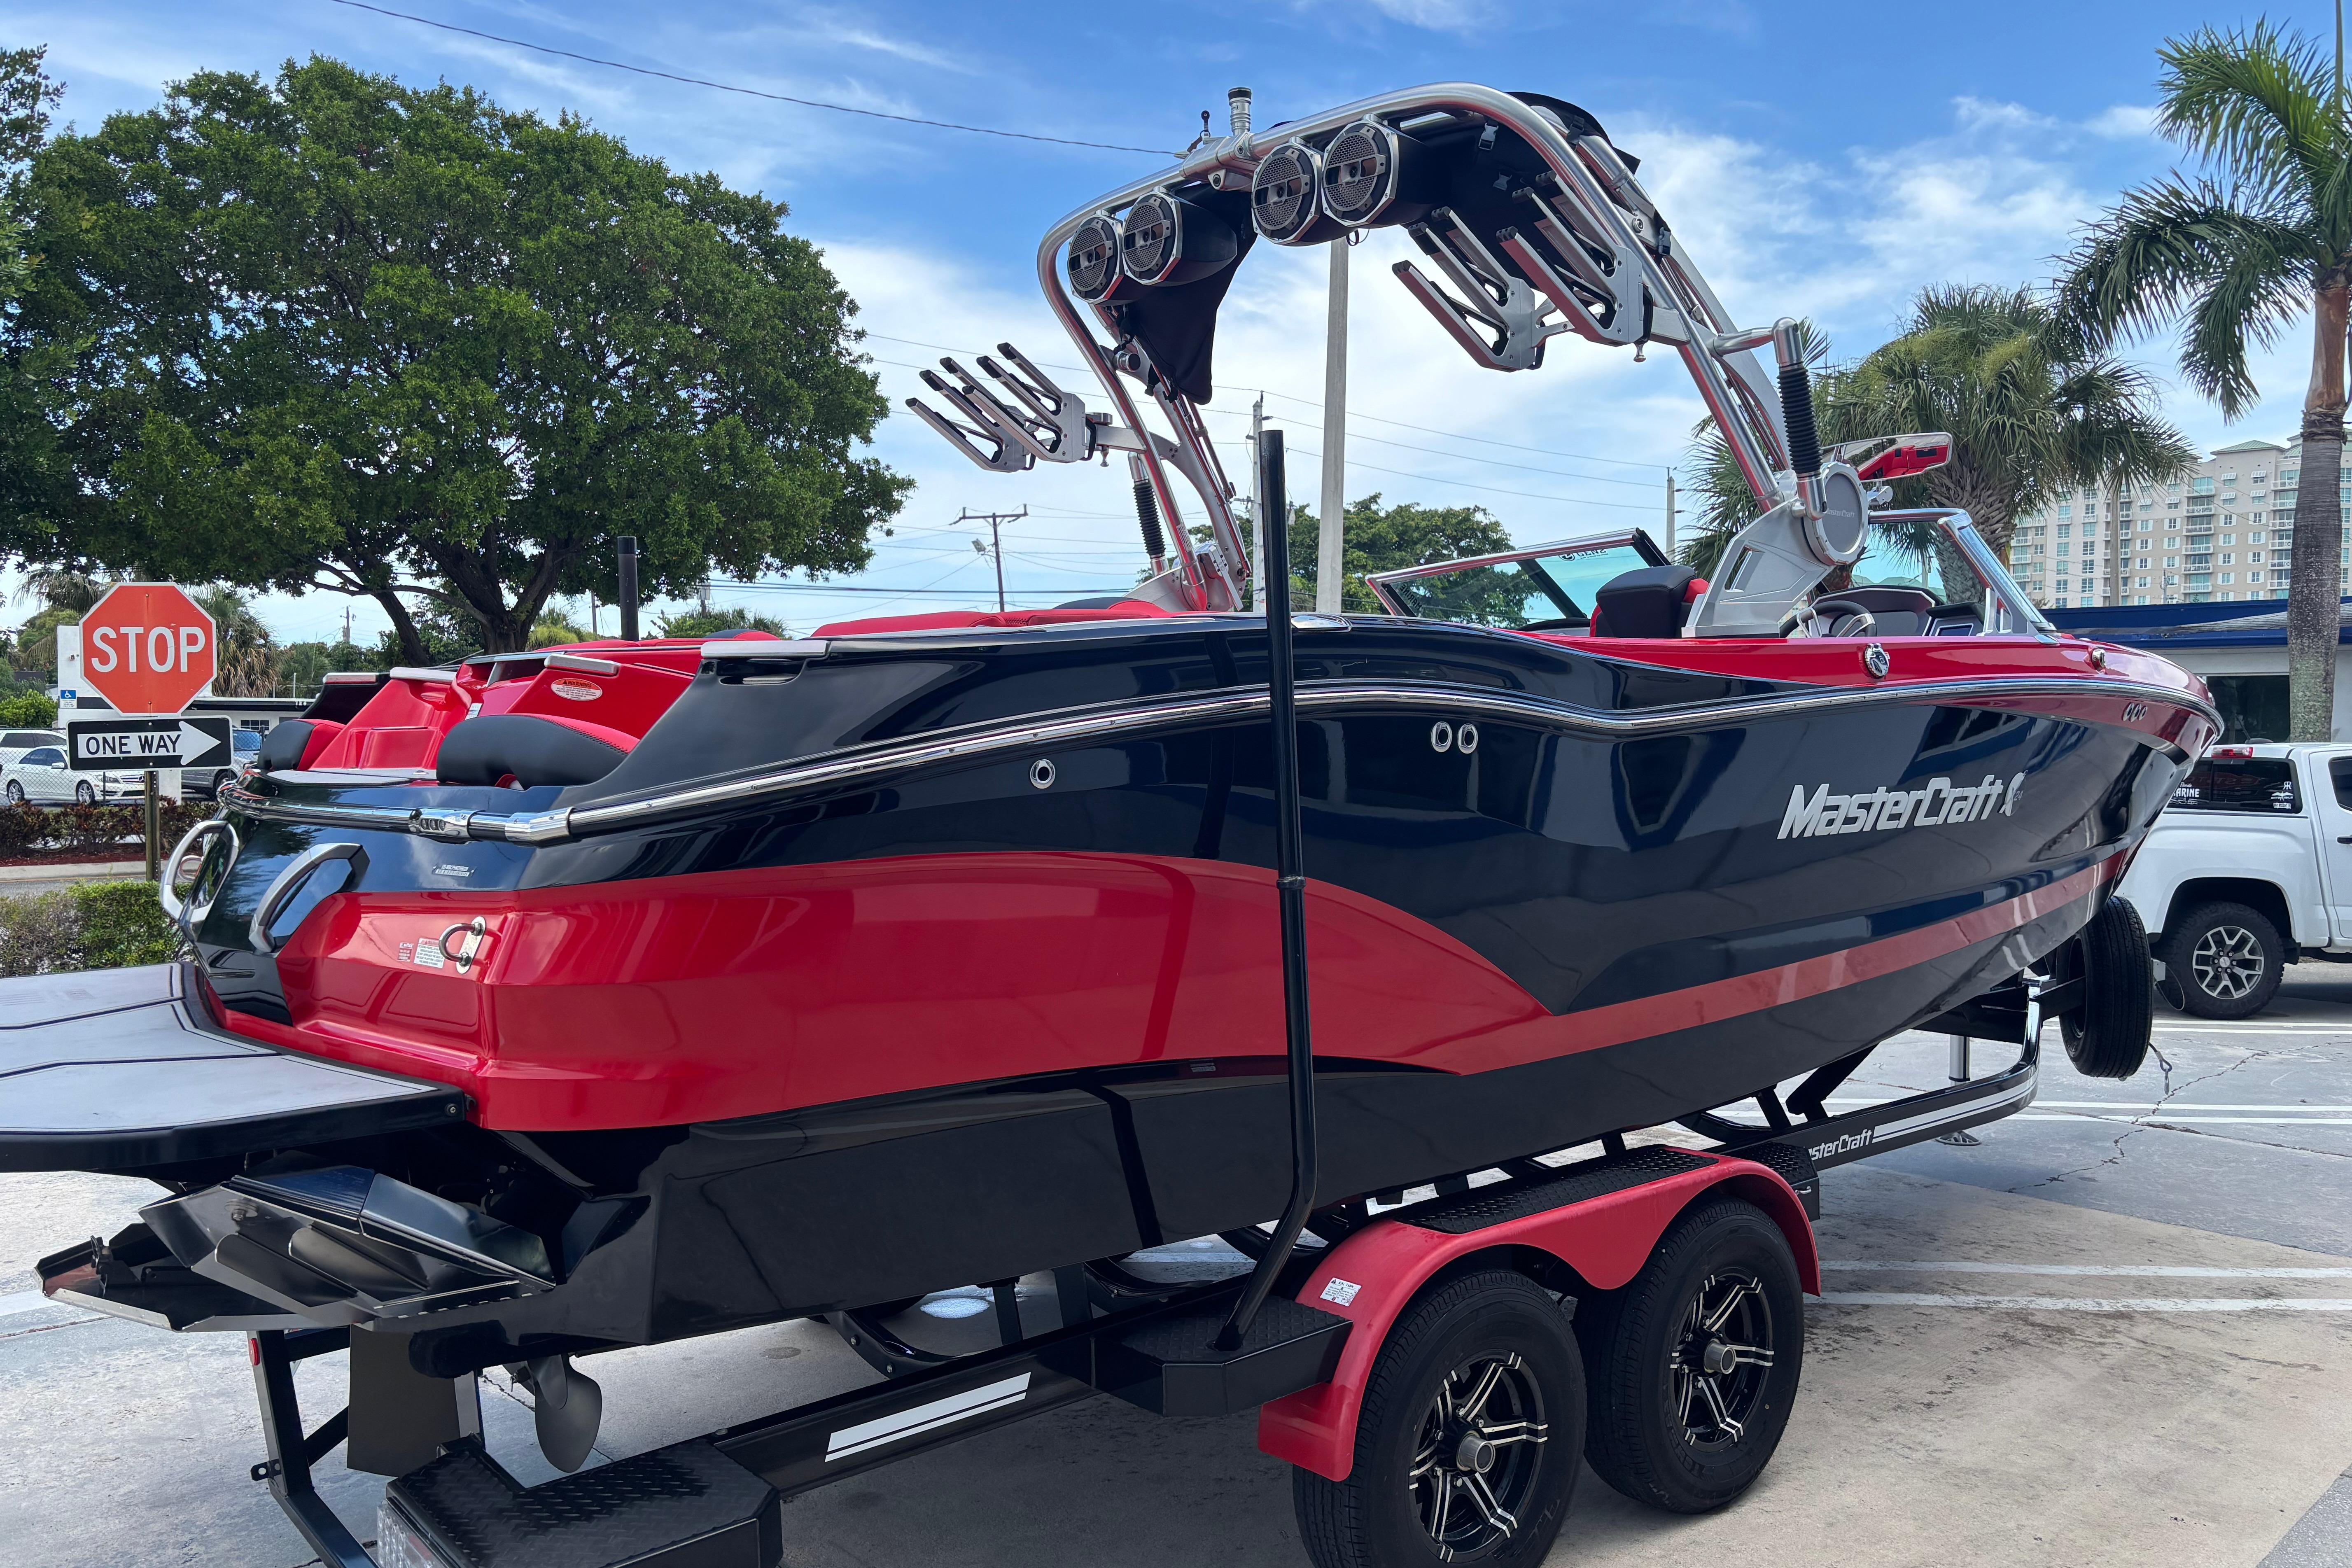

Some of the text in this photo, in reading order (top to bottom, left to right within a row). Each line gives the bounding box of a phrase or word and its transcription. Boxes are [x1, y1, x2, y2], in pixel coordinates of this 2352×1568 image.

[91, 626, 205, 672] STOP
[86, 734, 181, 755] ONE WAY
[1777, 775, 2004, 839] MasterCraft
[2174, 788, 2200, 798] ARINE
[1808, 1129, 1872, 1160] sterCraft
